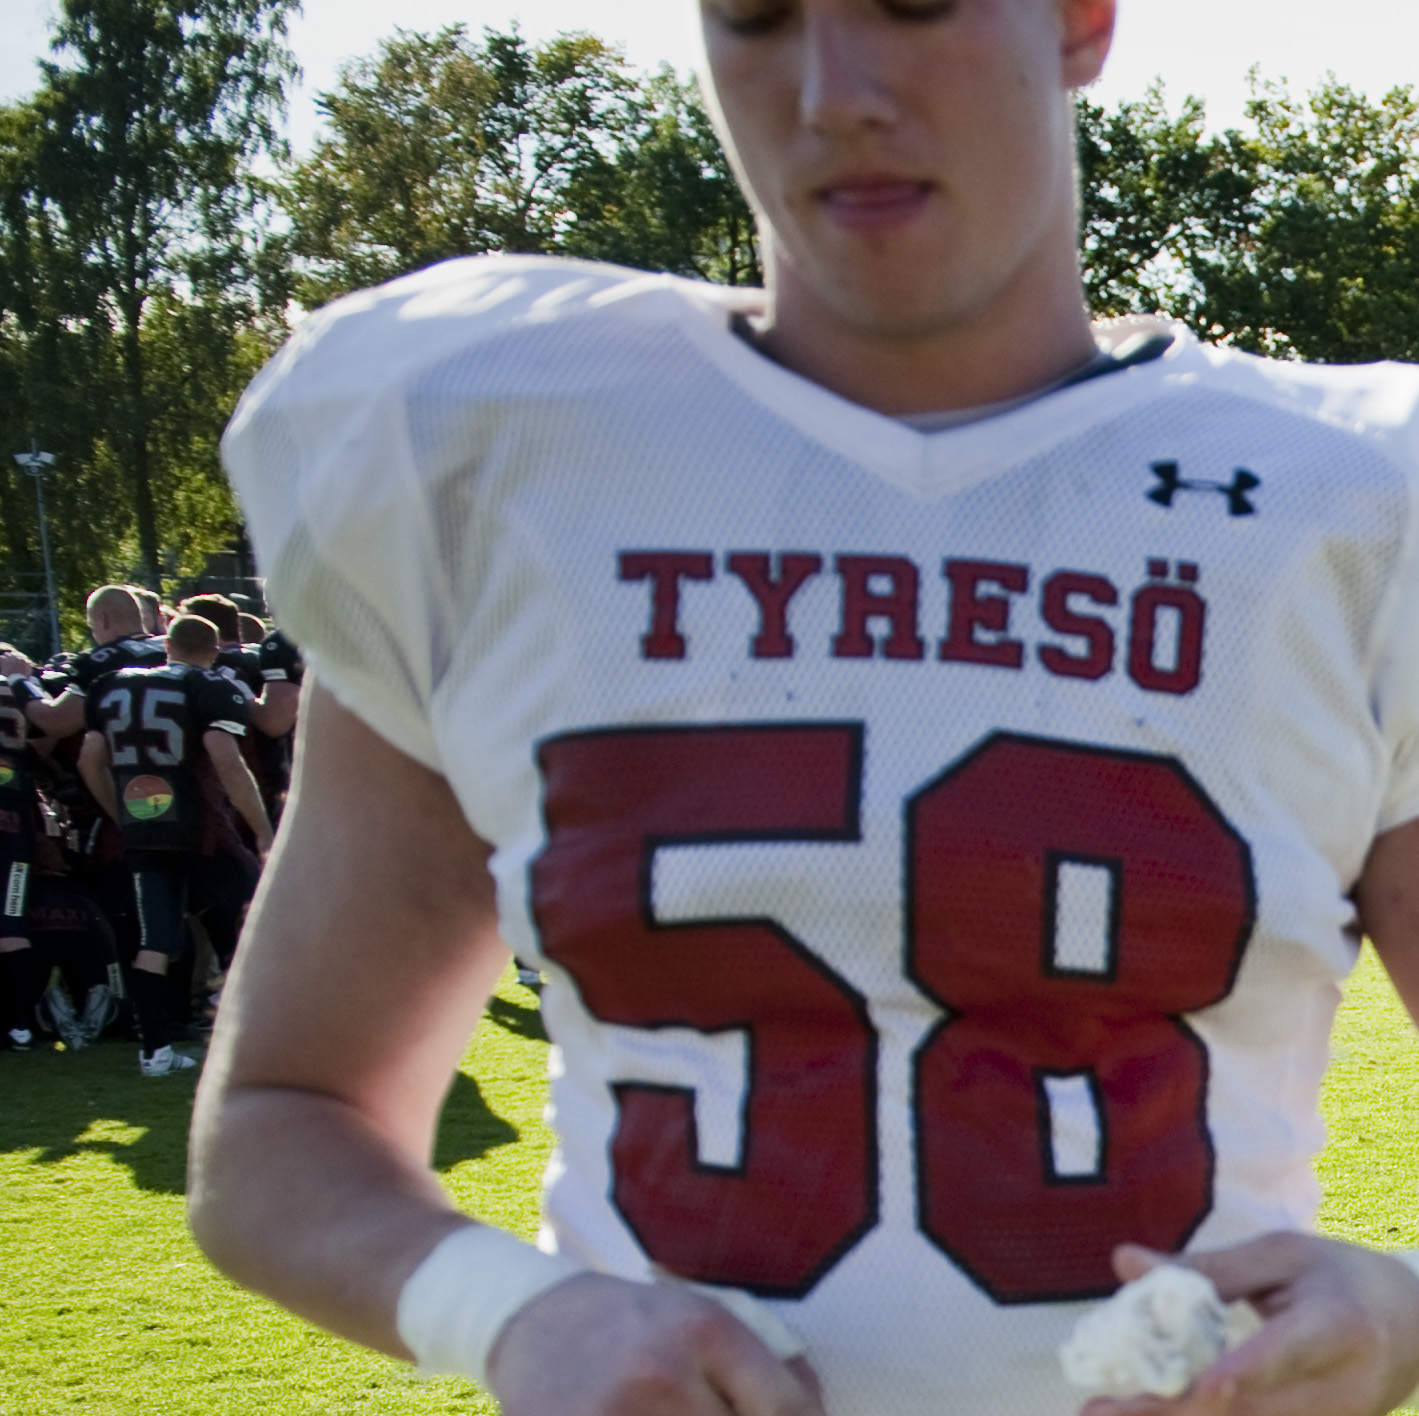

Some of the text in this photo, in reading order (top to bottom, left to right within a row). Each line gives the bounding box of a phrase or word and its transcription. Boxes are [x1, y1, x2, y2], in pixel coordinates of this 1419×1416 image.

[618, 548, 1207, 697] TYRESÖ
[101, 689, 185, 766] 25
[530, 720, 1257, 1306] 58
